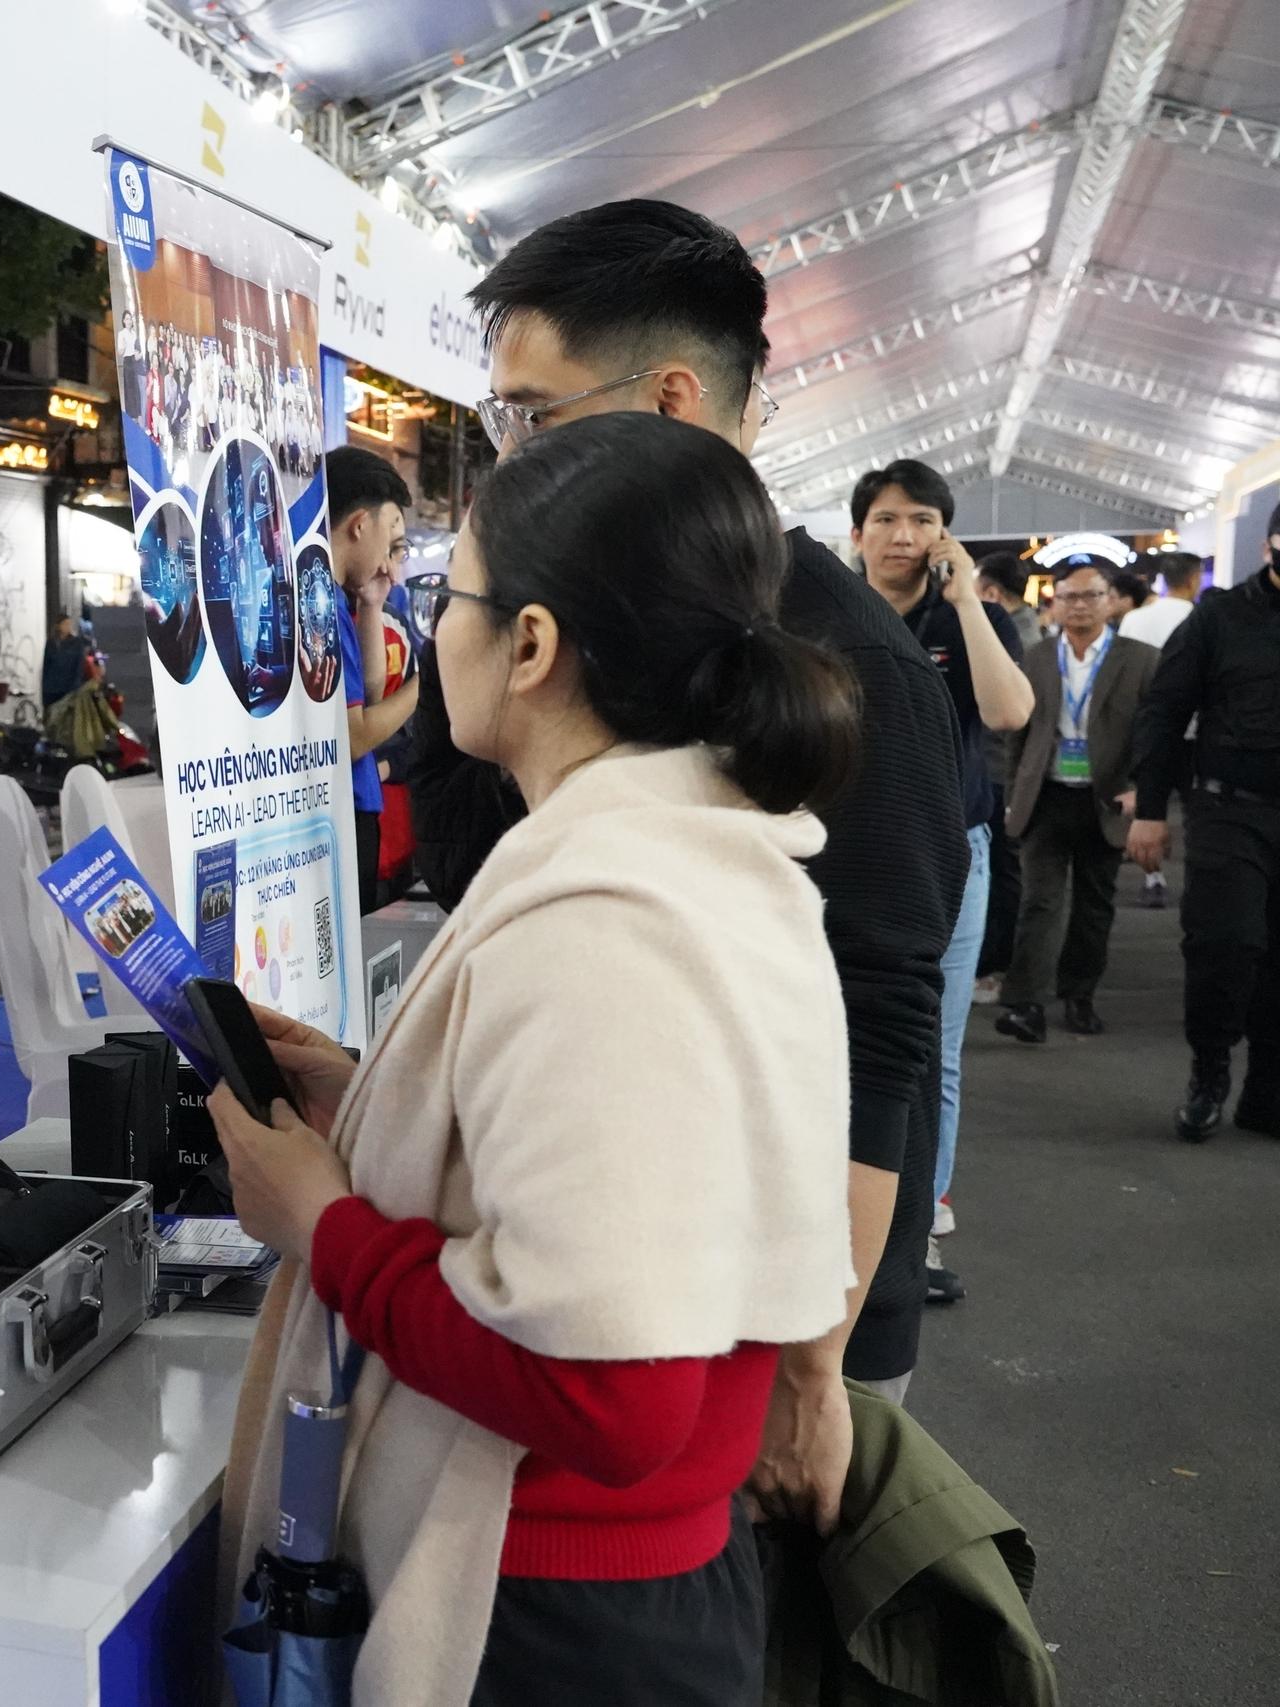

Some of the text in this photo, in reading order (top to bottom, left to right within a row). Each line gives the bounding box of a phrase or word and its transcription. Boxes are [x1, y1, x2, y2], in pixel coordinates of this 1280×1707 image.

[123, 213, 151, 243] AIUNI
[178, 736, 338, 803] HỌC VIỆN CÔNG NGHỆ AIUNI
[191, 803, 232, 838] LEARN
[235, 801, 245, 828] AI
[252, 795, 277, 824] LEAD
[279, 789, 302, 816] THE
[302, 783, 329, 812] FUTURE
[248, 866, 255, 883] 12
[273, 872, 296, 899] CHIẾN
